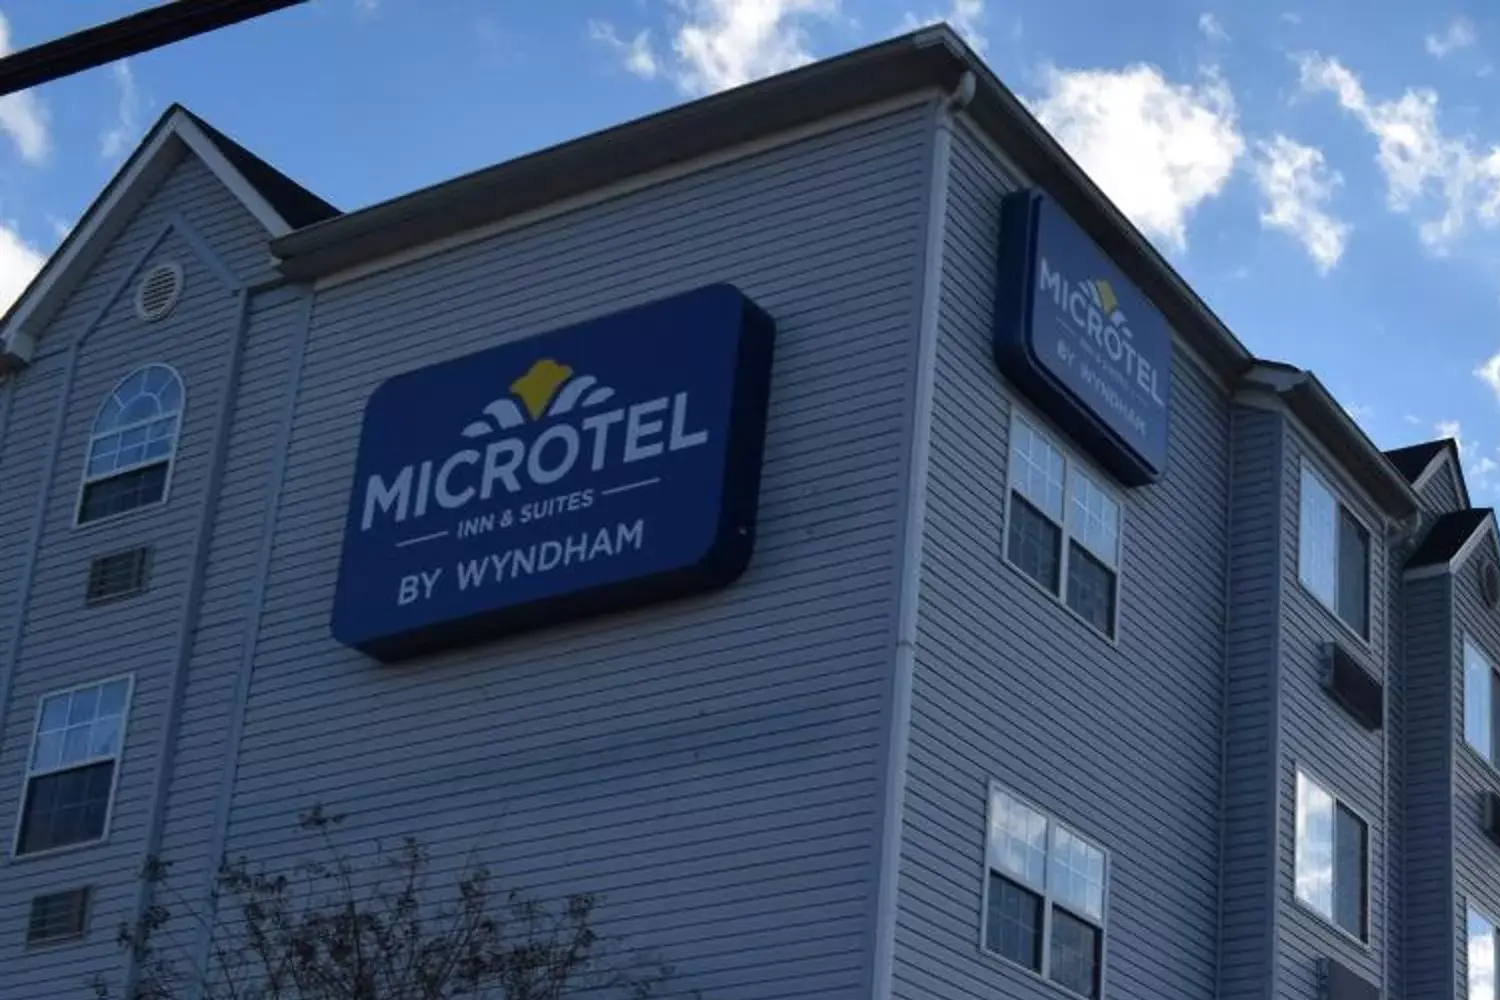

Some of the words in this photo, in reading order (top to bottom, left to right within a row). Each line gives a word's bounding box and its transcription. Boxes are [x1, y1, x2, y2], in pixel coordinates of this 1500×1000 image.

[1039, 255, 1165, 406] MICROTEL
[360, 391, 708, 531] MICROTEL
[457, 510, 495, 540] INN
[500, 509, 514, 529] &
[519, 488, 594, 524] SUITES
[397, 567, 443, 606] BY
[456, 518, 645, 592] WYNDHAM
